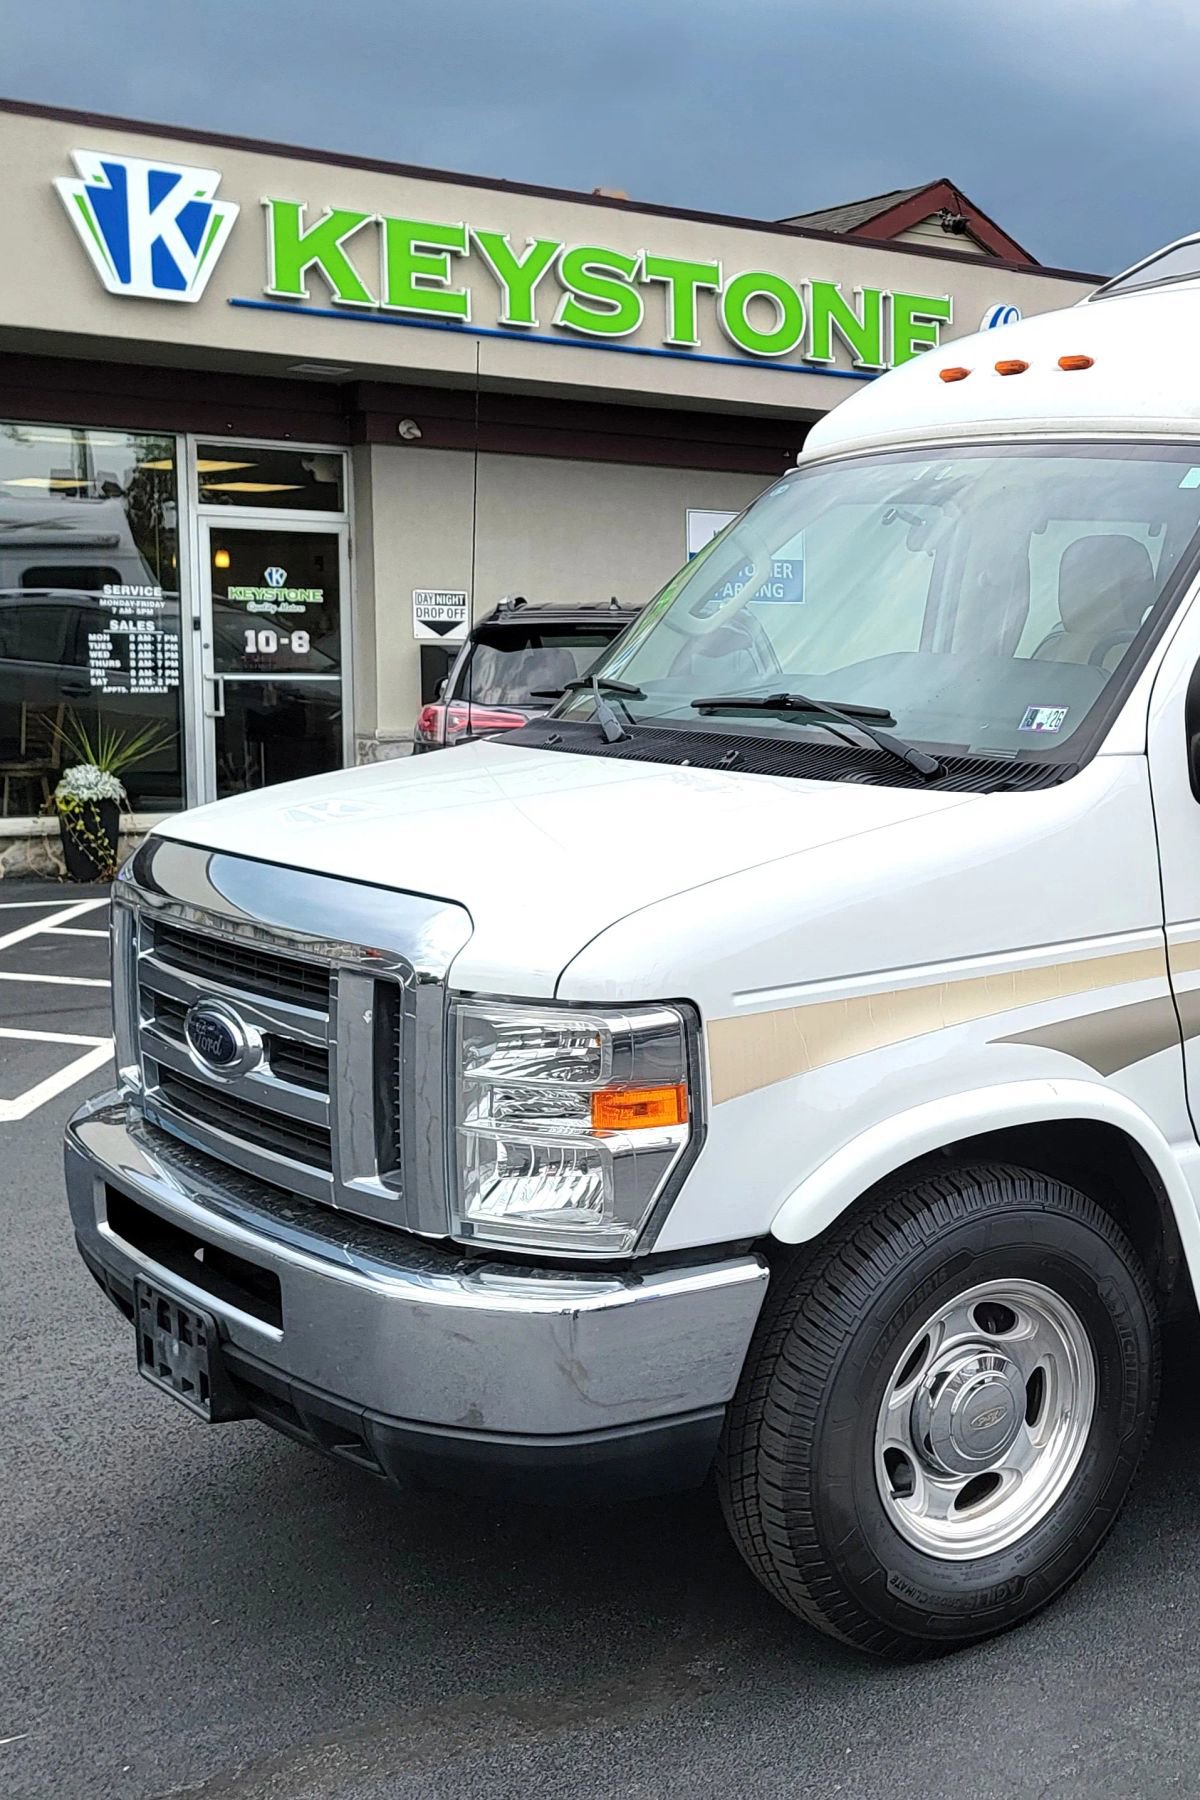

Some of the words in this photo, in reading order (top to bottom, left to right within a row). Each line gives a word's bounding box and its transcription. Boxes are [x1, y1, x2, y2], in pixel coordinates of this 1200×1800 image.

[261, 196, 954, 370] KEYSTONE
[103, 584, 162, 597] SERVICE
[228, 586, 323, 603] KEYSTONE
[99, 599, 165, 608] MONDAY-FRIDAY
[417, 593, 433, 604] DAY
[436, 594, 465, 605] NIGHT
[416, 607, 444, 618] DROP
[446, 608, 466, 619] OFF
[109, 620, 155, 631] SALES
[88, 633, 110, 641] MON
[163, 634, 178, 642] PM
[244, 630, 310, 653] 10-8
[88, 642, 113, 650] TUES
[164, 643, 178, 651] PM
[89, 650, 110, 659] WED
[164, 651, 178, 659] PM
[90, 659, 121, 668] THURS
[164, 660, 178, 668] PM
[90, 669, 105, 677] FRI
[164, 669, 179, 677] PM
[90, 678, 108, 686] SAT
[165, 678, 179, 686] PM
